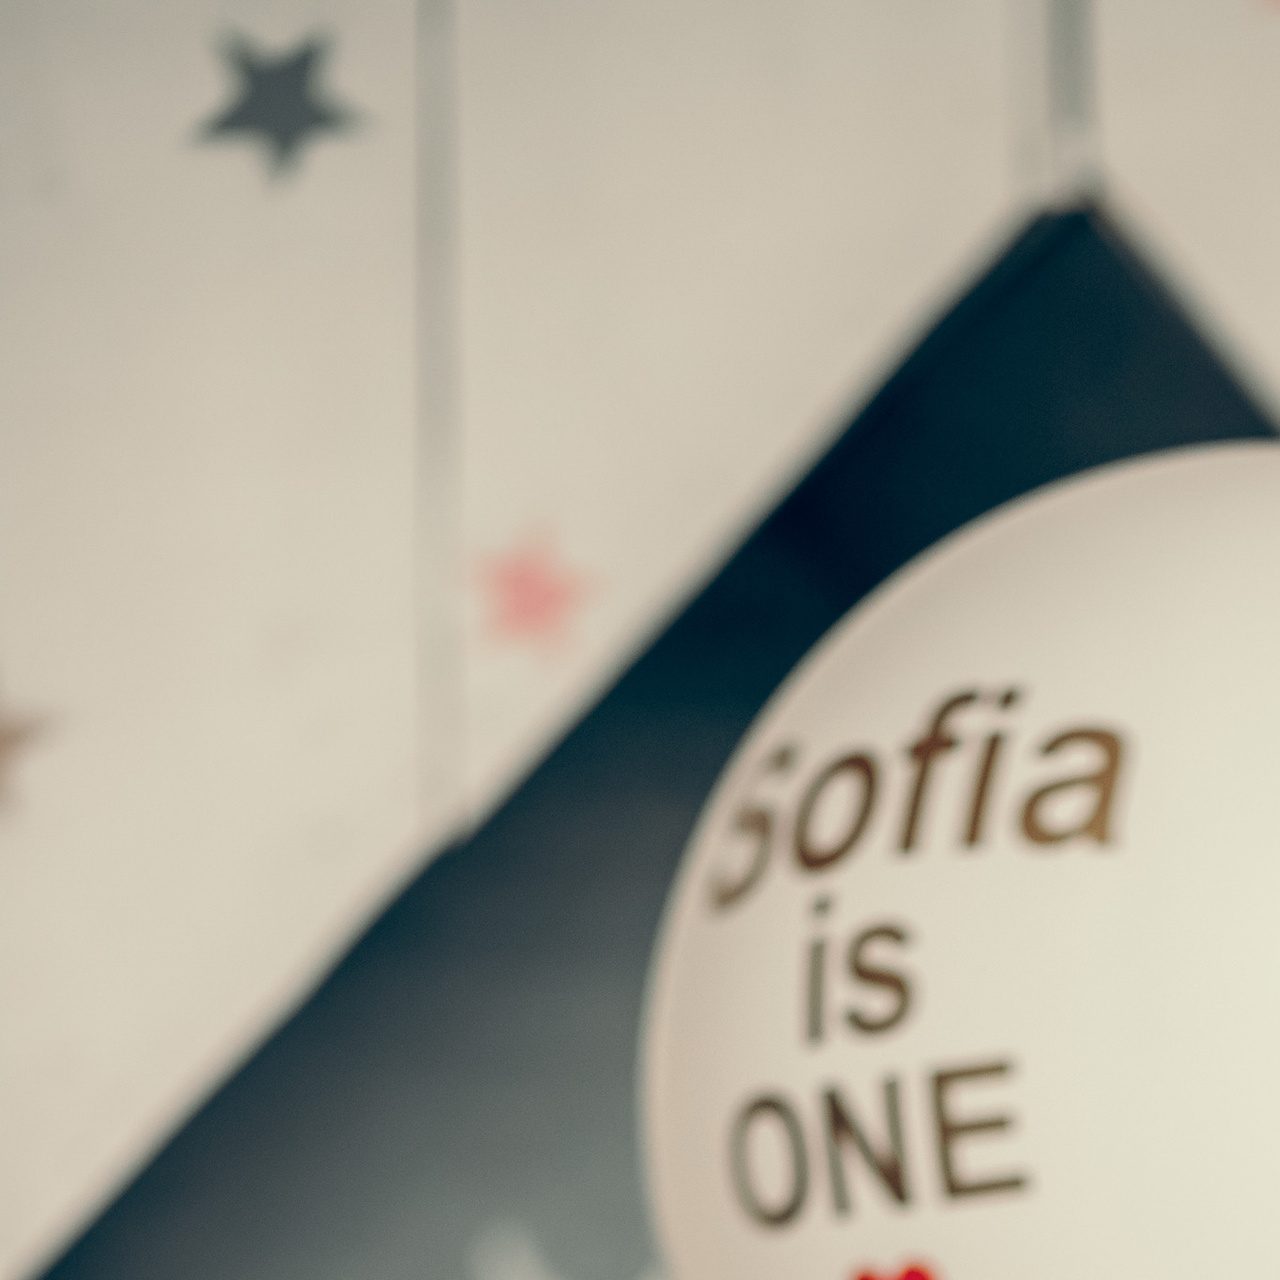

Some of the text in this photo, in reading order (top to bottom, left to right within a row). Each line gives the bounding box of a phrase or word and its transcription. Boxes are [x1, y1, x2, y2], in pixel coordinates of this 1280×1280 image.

[706, 688, 1128, 908] Sofia
[804, 898, 914, 1045] is
[729, 1062, 1030, 1230] ONE
